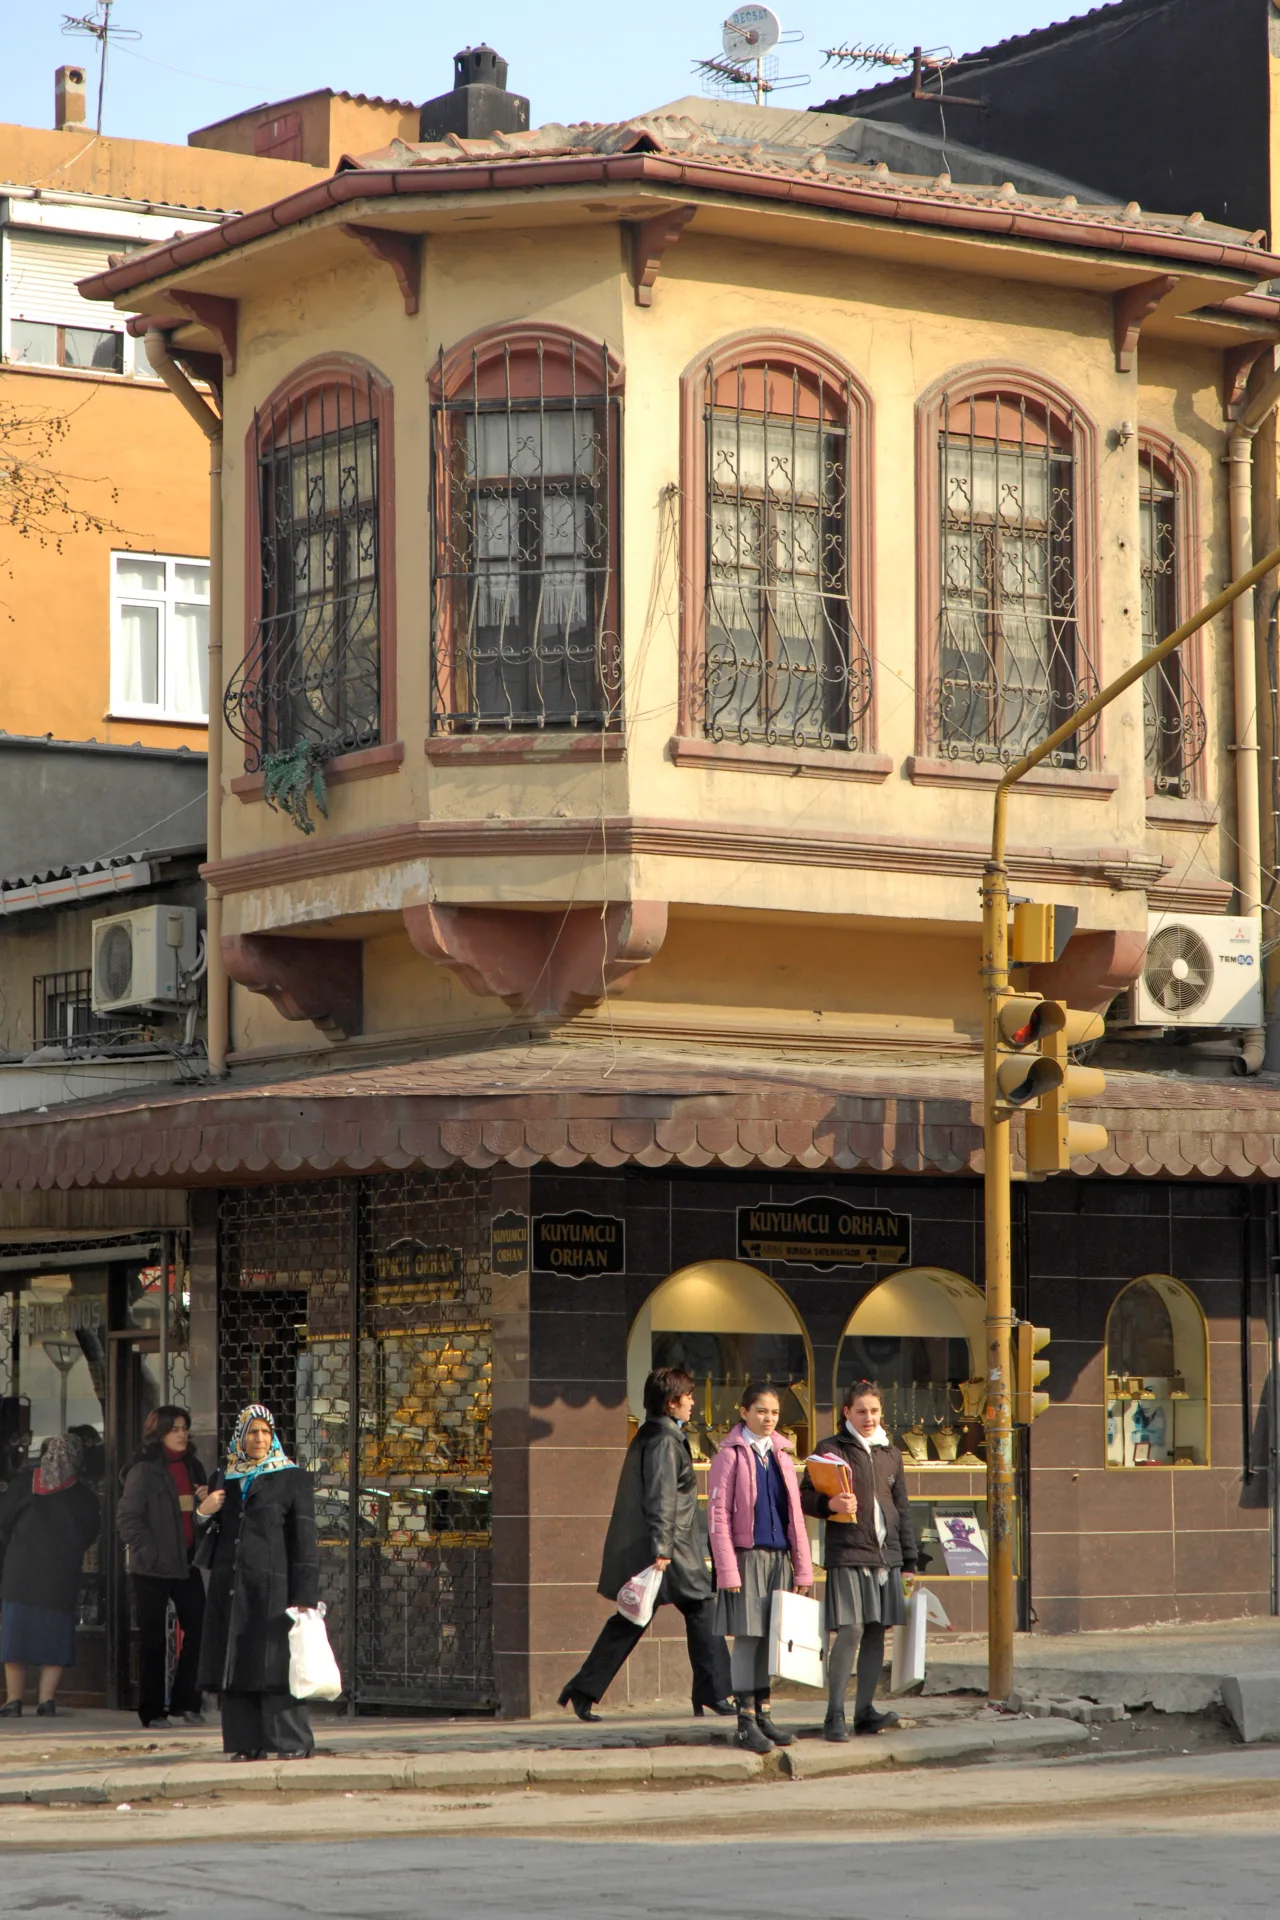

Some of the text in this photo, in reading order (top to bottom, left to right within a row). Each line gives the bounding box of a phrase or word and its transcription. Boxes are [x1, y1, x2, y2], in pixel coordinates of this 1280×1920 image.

[1219, 955, 1254, 966] TEMSA
[750, 1211, 899, 1237] KUYUMCU ORHAN
[493, 1228, 527, 1243] KUYUMCU
[540, 1223, 616, 1243] KUYUMCU
[496, 1247, 523, 1262] ORHAN
[550, 1248, 608, 1267] ORHAN
